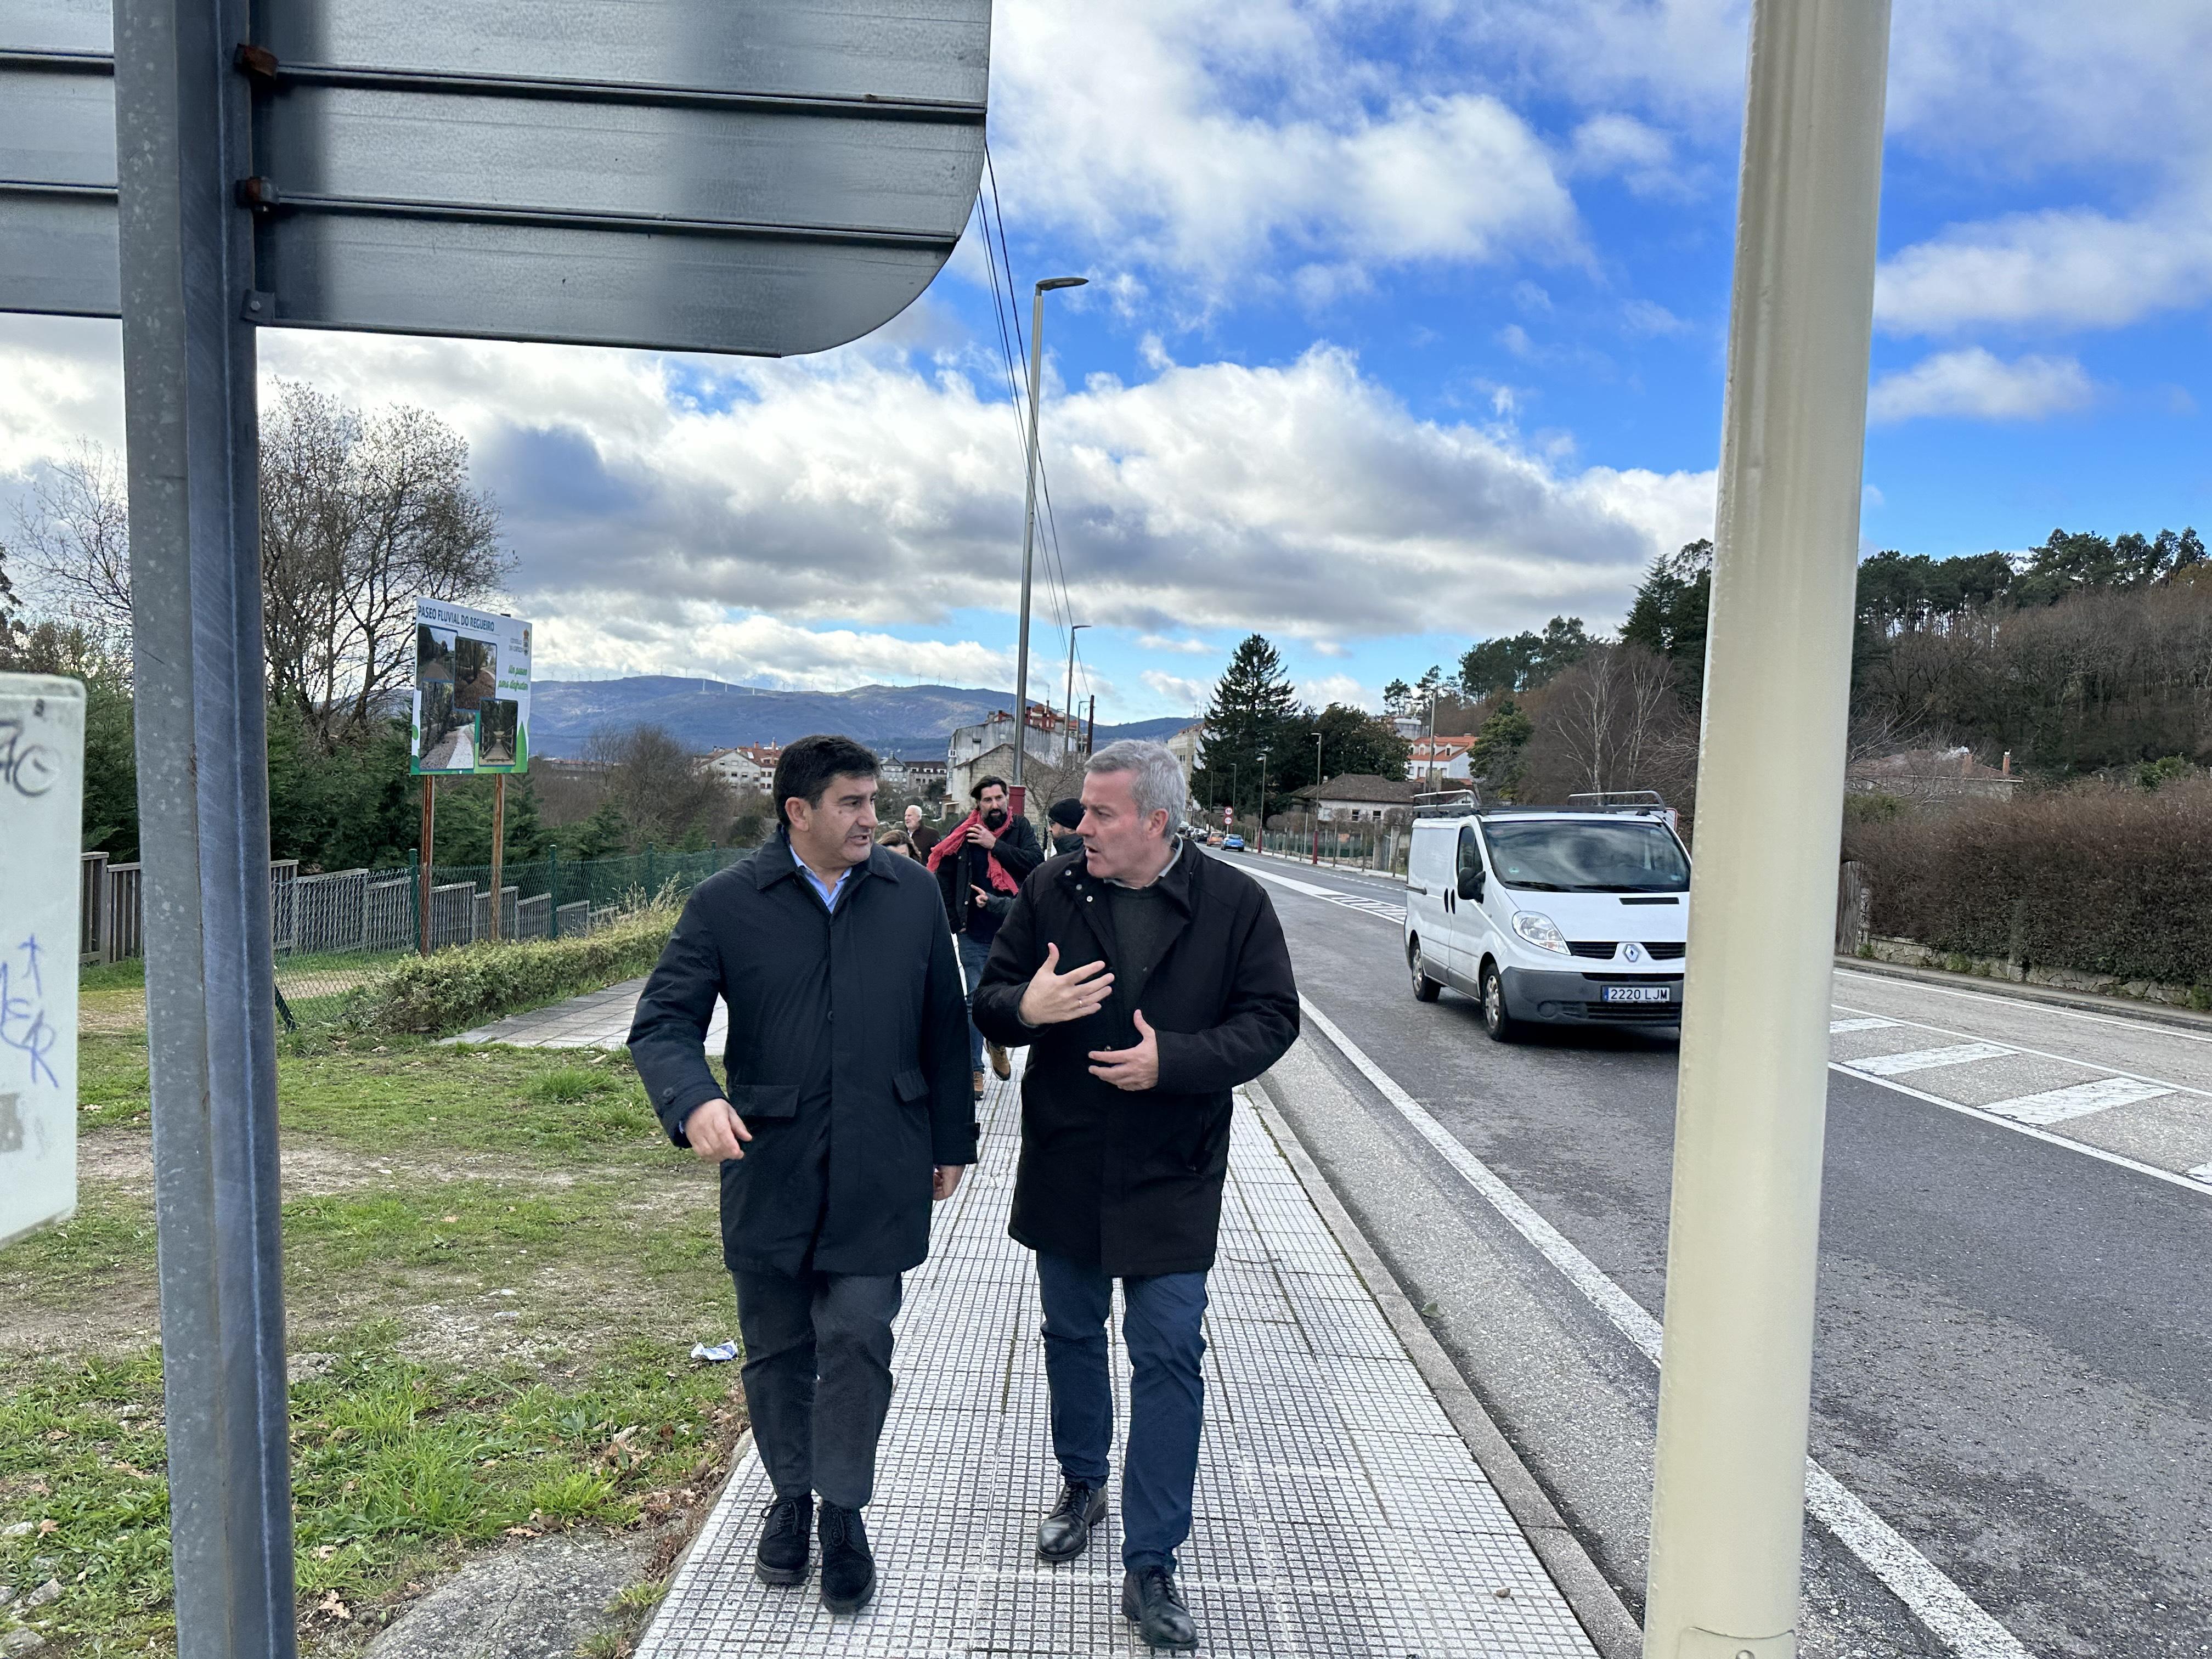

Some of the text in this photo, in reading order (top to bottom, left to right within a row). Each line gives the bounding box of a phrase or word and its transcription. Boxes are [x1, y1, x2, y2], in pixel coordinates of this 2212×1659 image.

[418, 605, 494, 631] PASEO FLUVIAL DO REGUEIRO
[1611, 989, 1667, 1000] 2220 LJM
